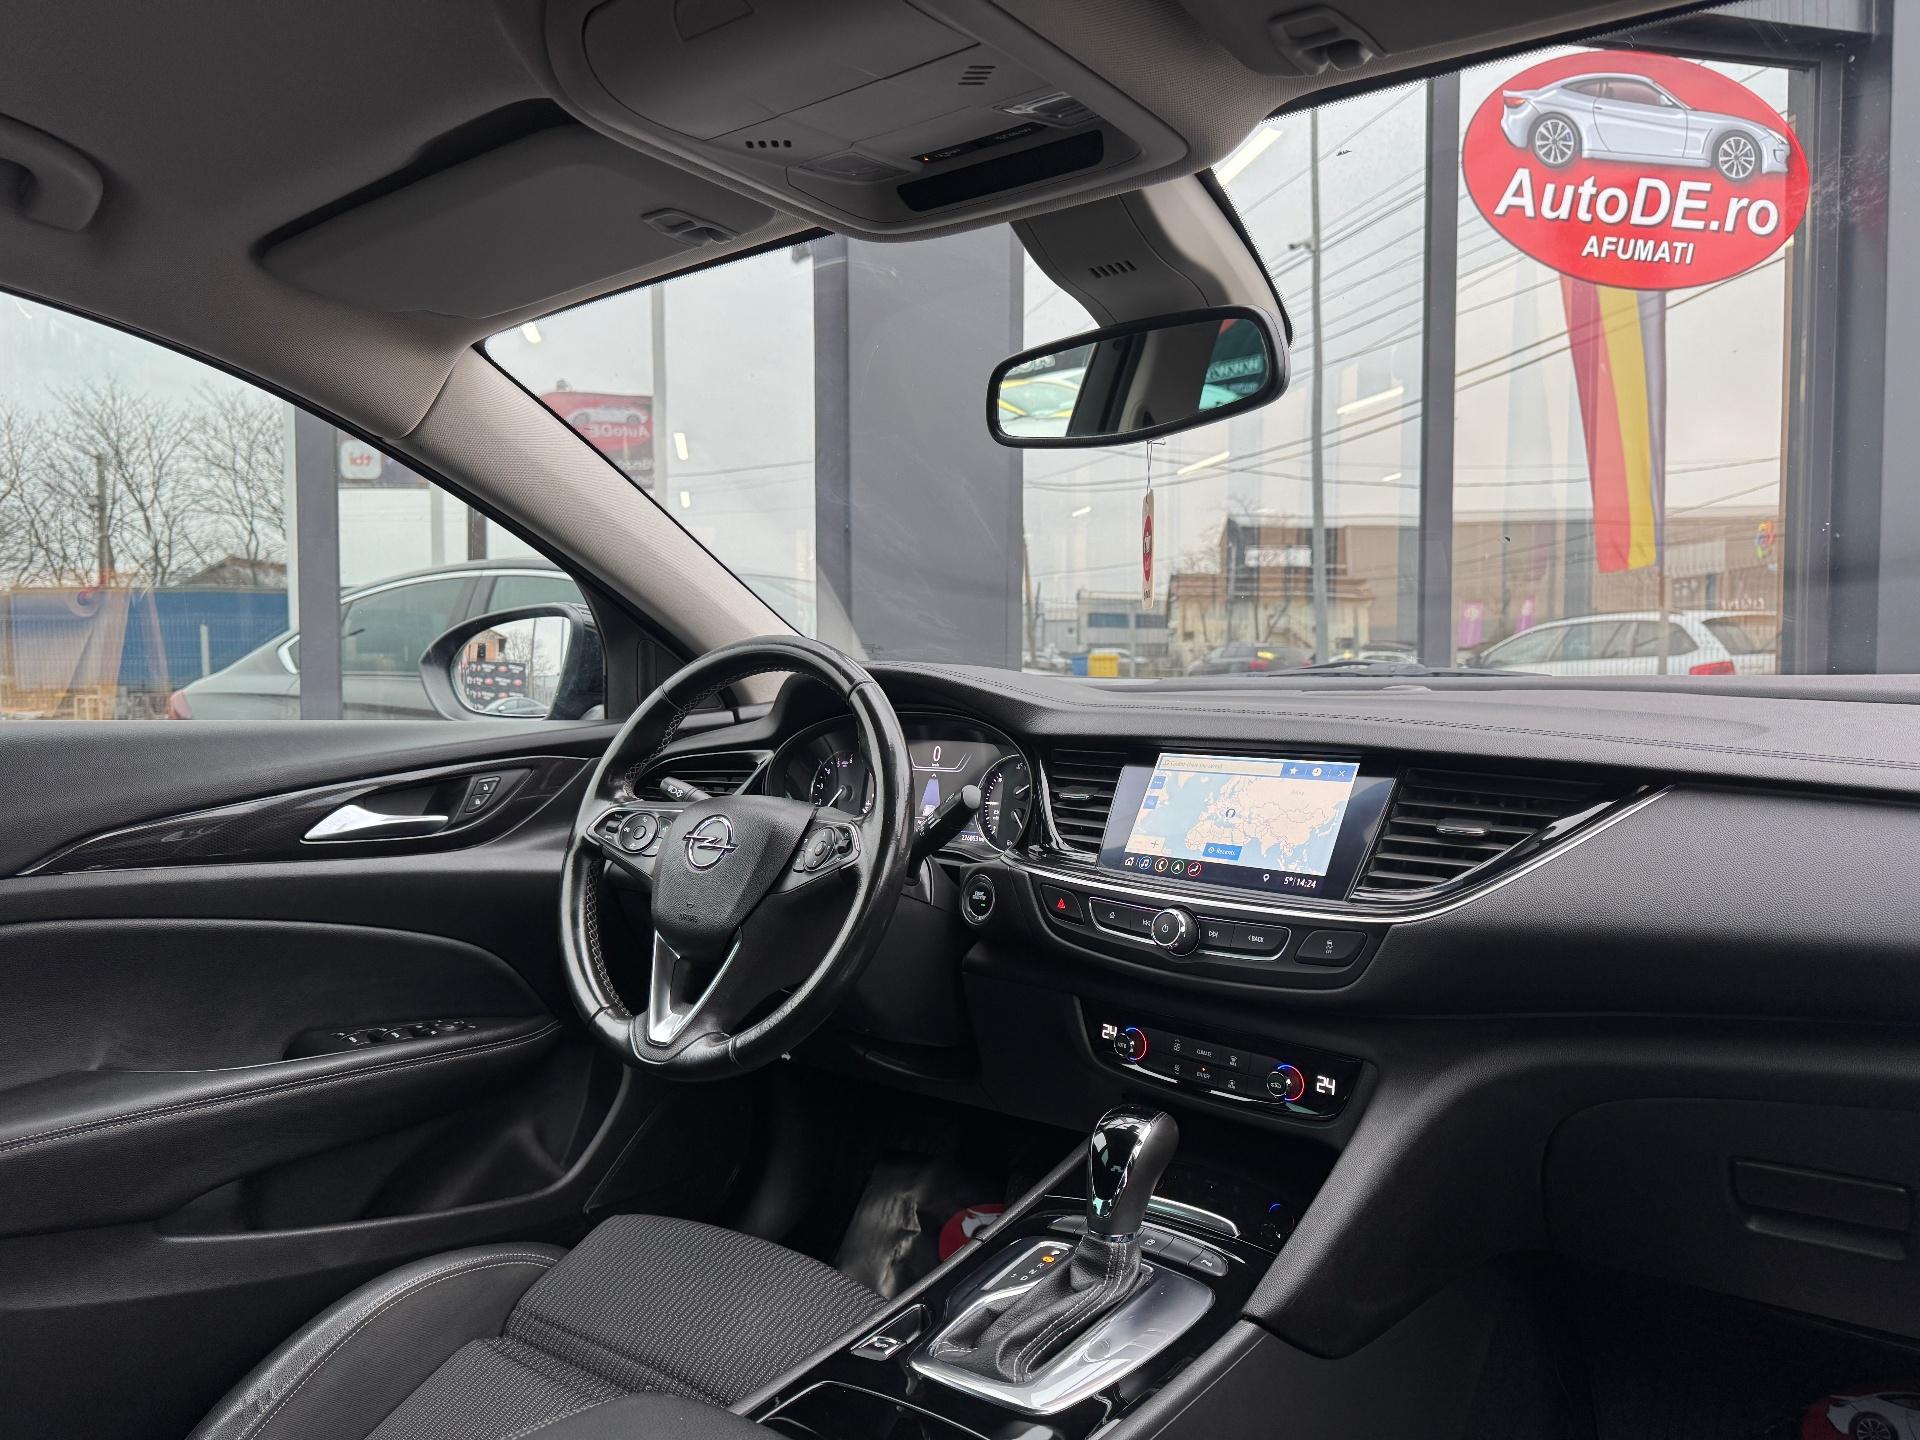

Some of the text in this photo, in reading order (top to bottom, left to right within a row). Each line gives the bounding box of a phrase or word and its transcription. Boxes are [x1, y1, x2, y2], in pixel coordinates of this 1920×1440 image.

[1494, 166, 1780, 237] AutoDE.ro
[1581, 235, 1694, 265] AFUMATI
[933, 745, 942, 762] 0
[1296, 878, 1317, 889] 14:24
[1251, 935, 1265, 943] BACK
[1101, 1023, 1118, 1040] 24
[1316, 1075, 1336, 1096] 24
